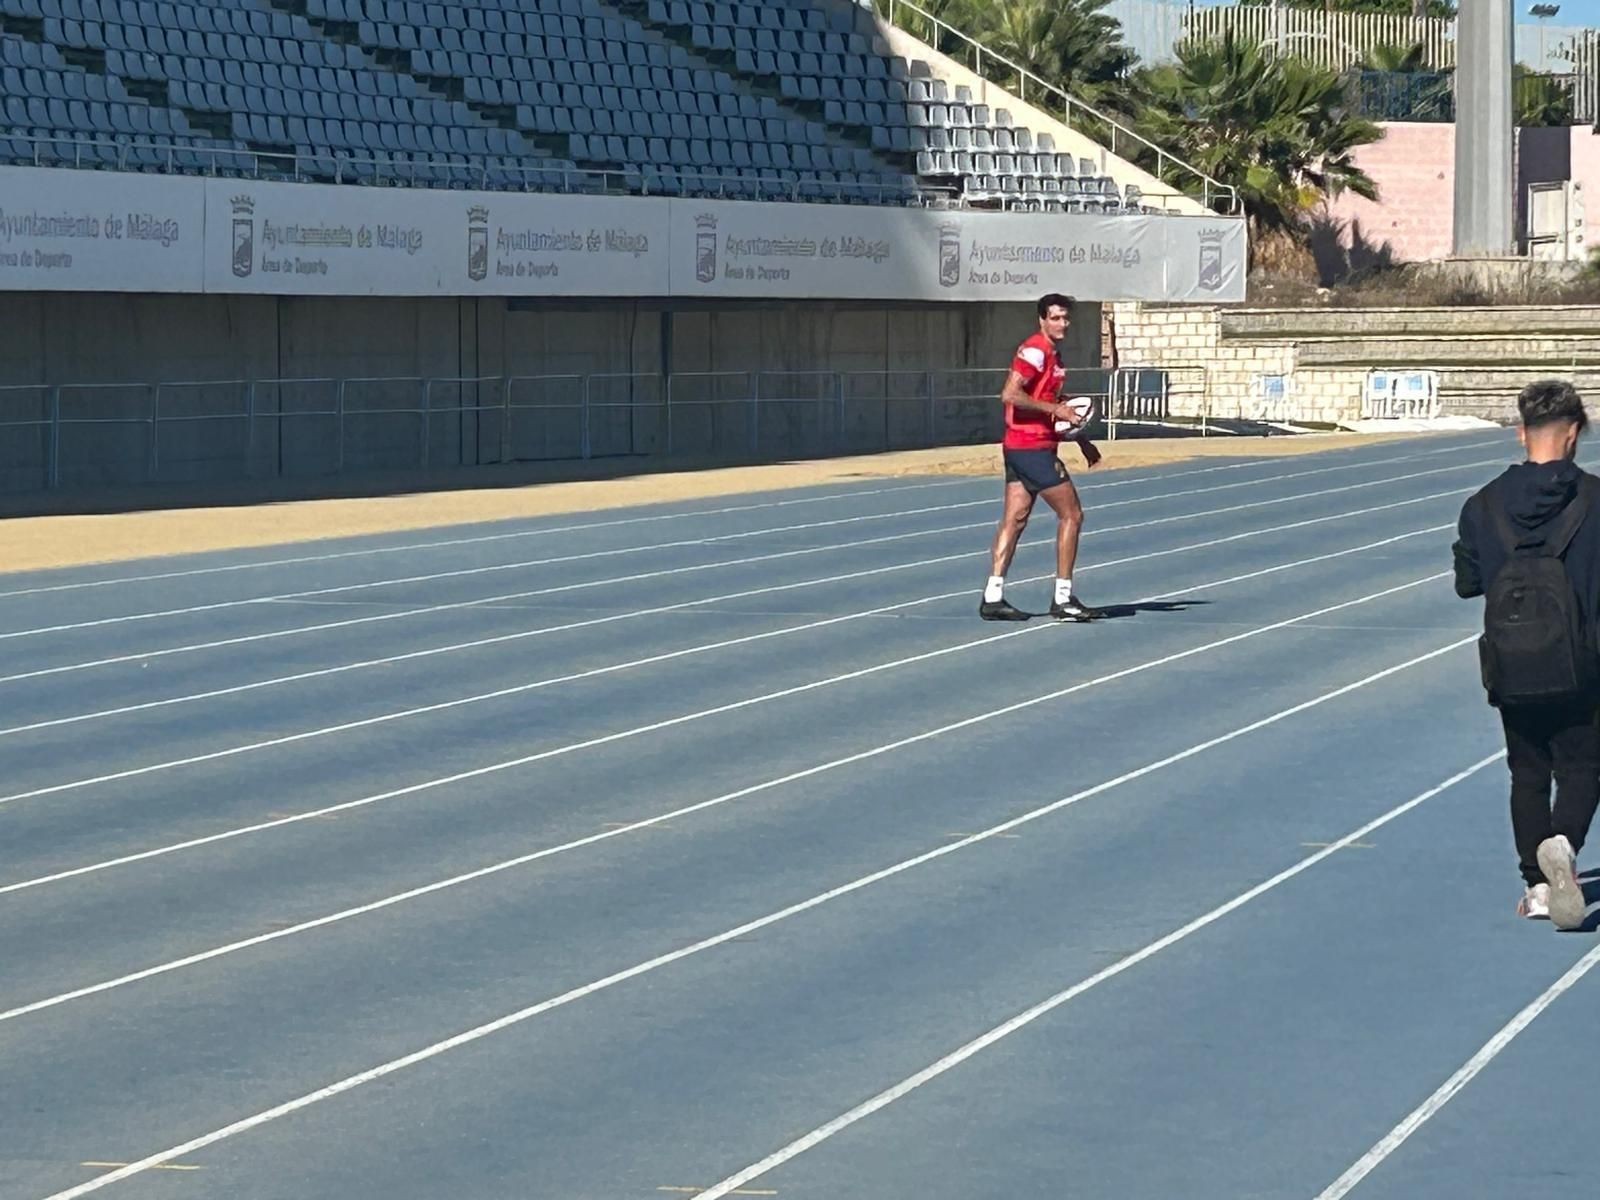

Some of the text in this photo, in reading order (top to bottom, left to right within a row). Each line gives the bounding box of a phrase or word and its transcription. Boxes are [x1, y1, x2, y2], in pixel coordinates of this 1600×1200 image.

[105, 213, 122, 239] de
[358, 224, 372, 248] de
[587, 228, 601, 252] de
[820, 236, 837, 257] de
[1070, 244, 1086, 264] de
